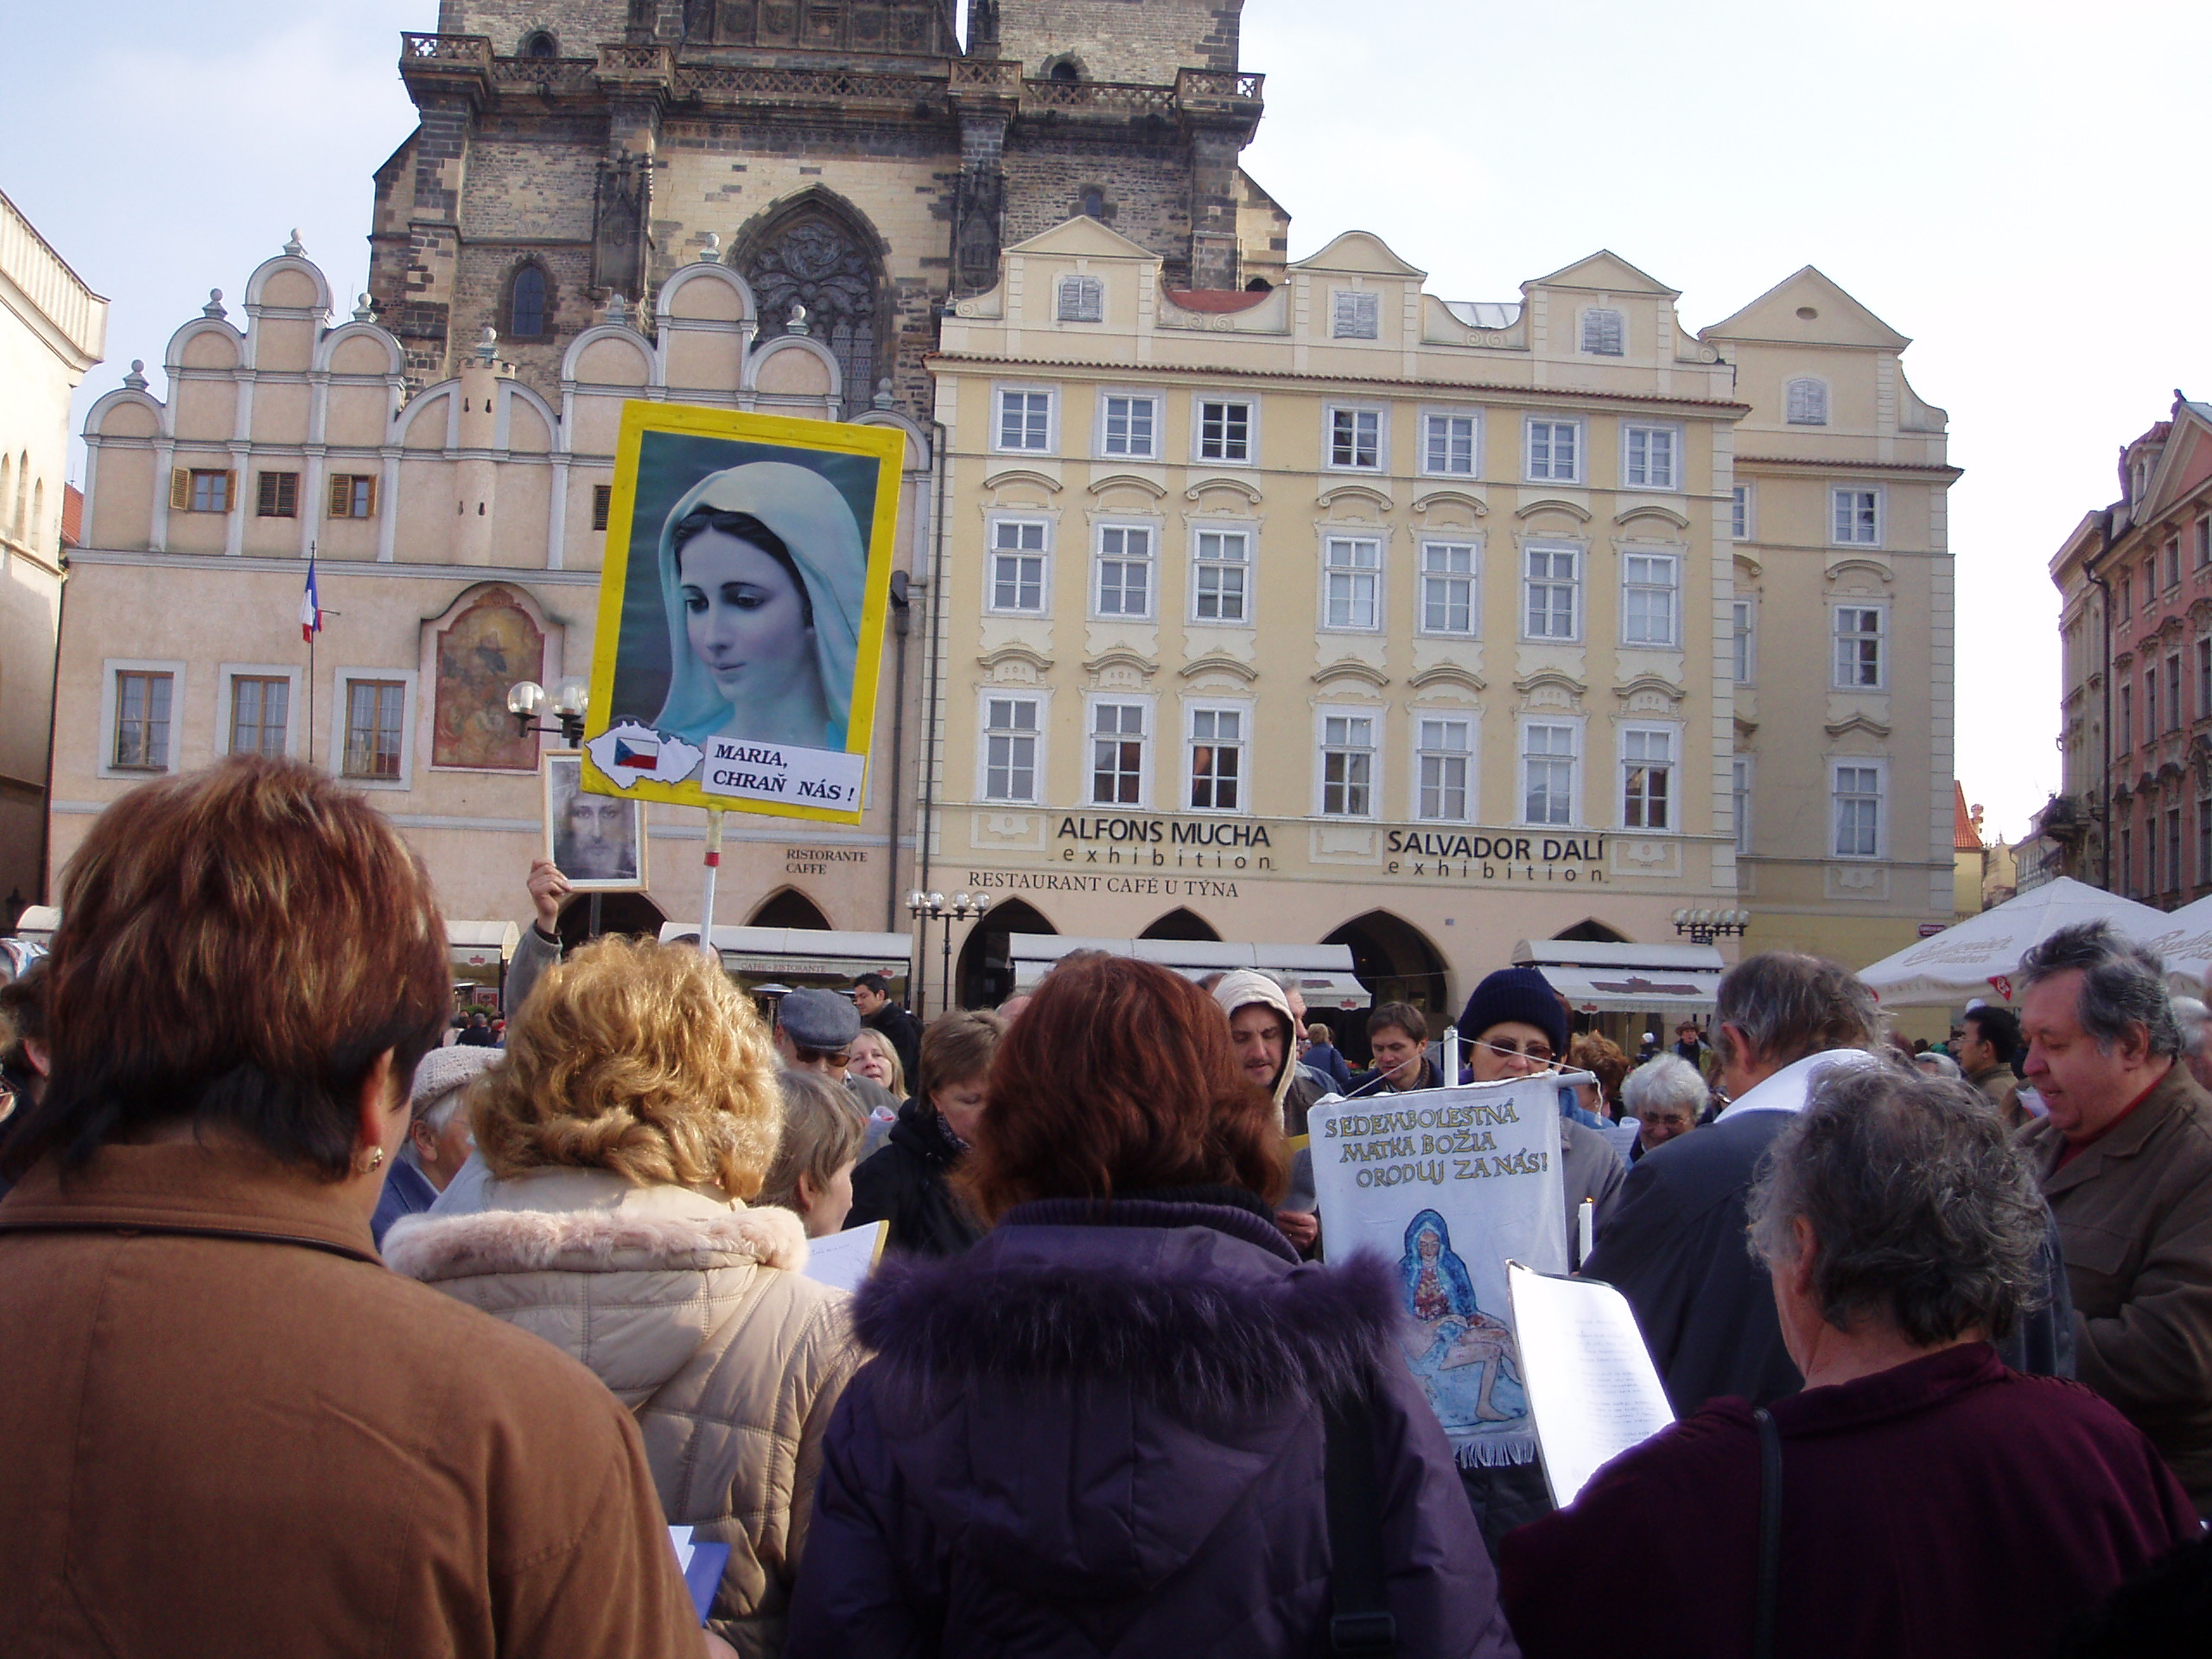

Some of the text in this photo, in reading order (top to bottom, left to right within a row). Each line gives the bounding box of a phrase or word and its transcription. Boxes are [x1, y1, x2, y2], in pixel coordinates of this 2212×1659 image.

[714, 743, 788, 769] MARIA,
[713, 769, 787, 793] CHRAŇ
[1057, 817, 1271, 848] ALFONS MUCHA
[1387, 830, 1605, 861] SALVADOR DALÍ
[786, 849, 868, 862] RISTORANTE
[1063, 846, 1271, 870] exhibition
[1388, 859, 1603, 882] exhibition
[968, 871, 1239, 898] RESTAURANT CAFÉ U TÝNA
[1339, 1128, 1497, 1163] MATKA BOŽIA
[1356, 1159, 1446, 1188] ORODUJ
